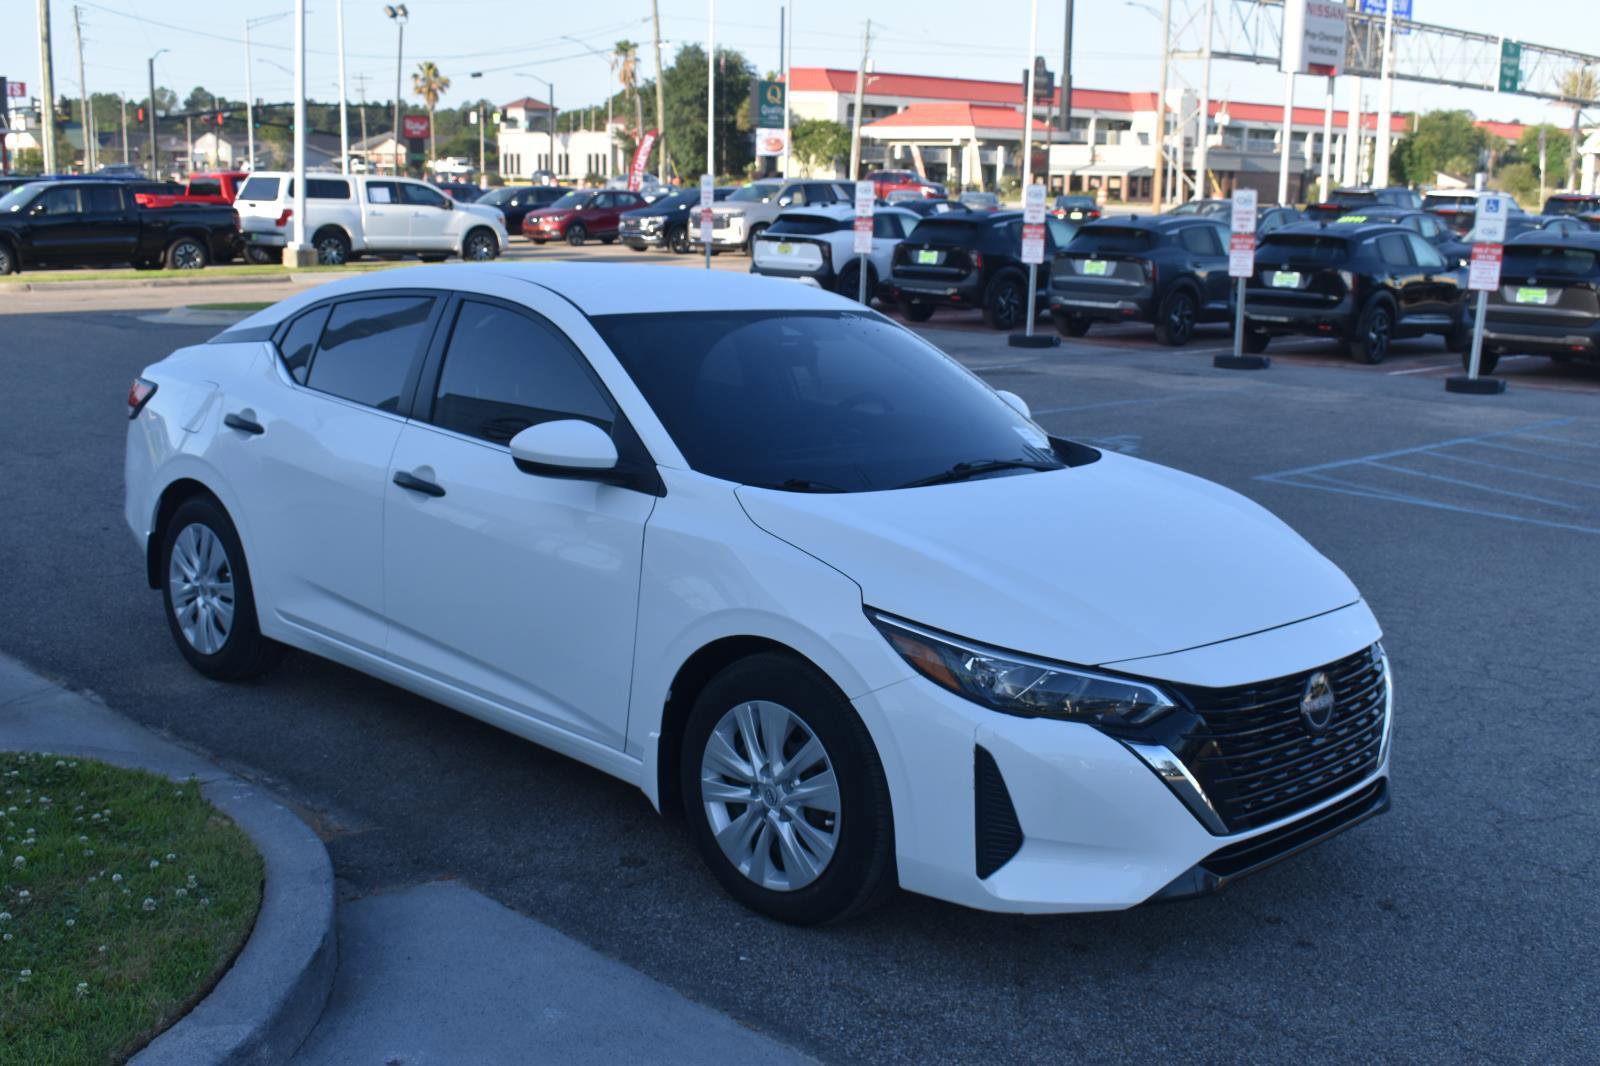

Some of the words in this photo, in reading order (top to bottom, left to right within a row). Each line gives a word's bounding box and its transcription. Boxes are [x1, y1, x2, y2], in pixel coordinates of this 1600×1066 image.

[1306, 3, 1345, 20] NISSAN
[1304, 29, 1343, 43] Pre-Owned
[1308, 44, 1338, 56] Vehicles
